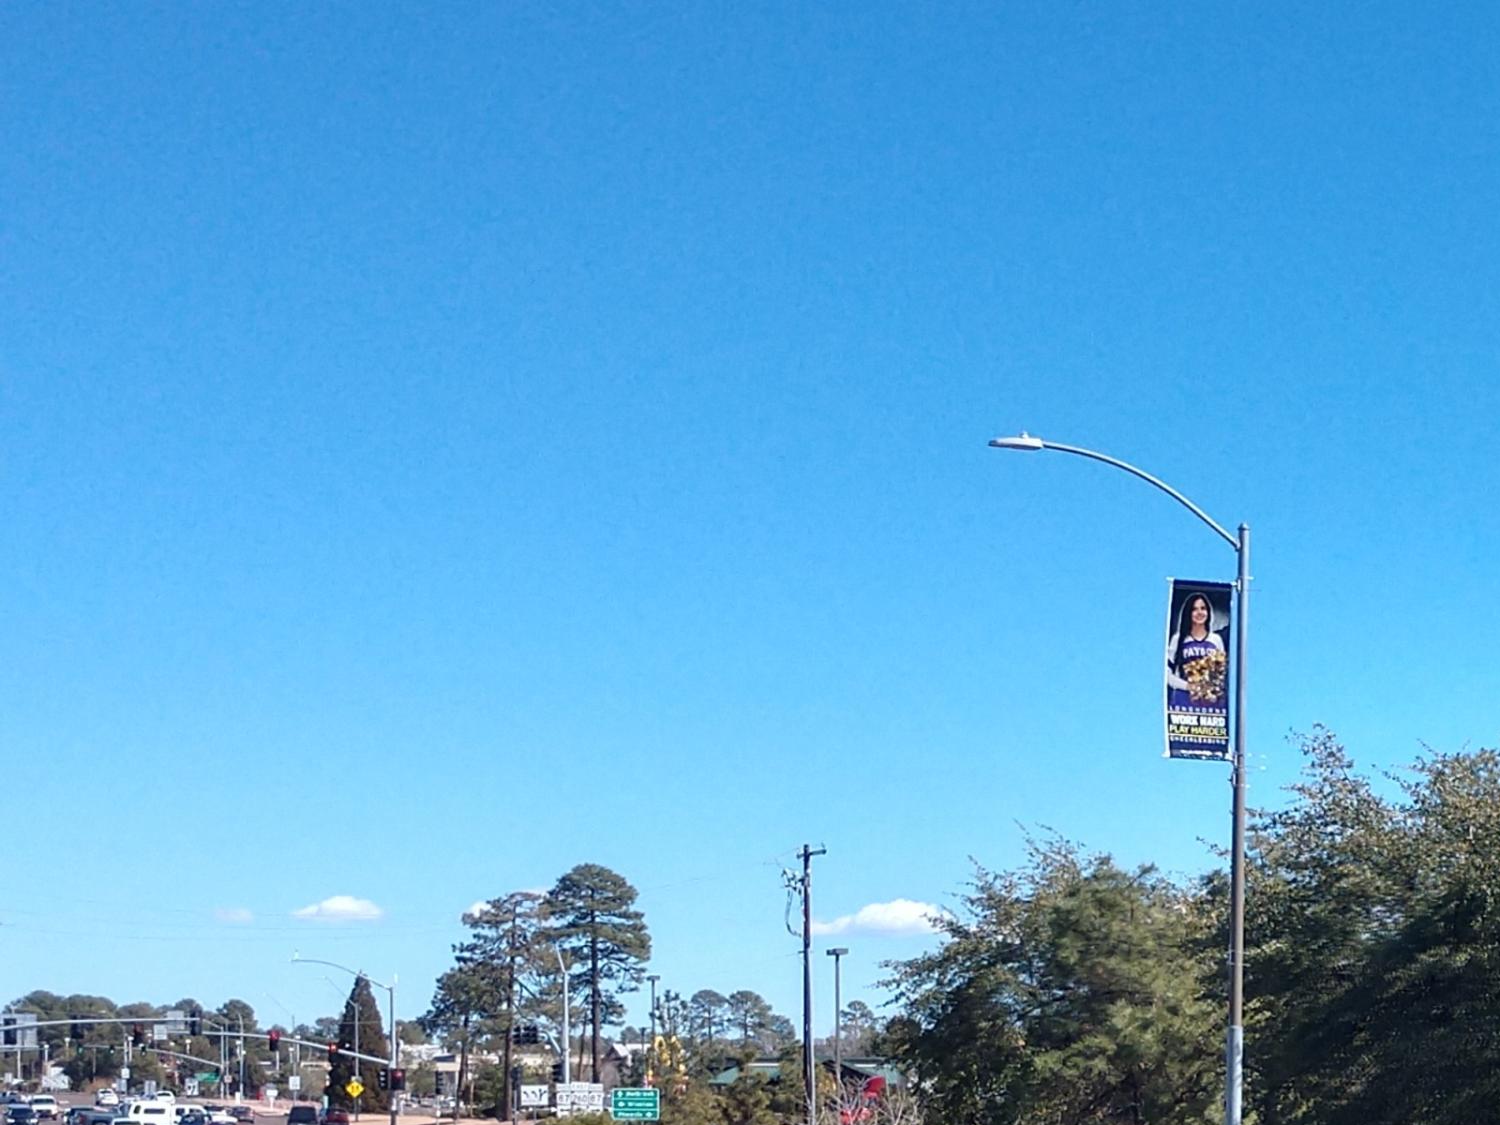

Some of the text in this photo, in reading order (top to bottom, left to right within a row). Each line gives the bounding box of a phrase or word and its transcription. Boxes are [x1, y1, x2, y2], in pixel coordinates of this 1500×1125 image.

[1169, 705, 1227, 714] LONGHORNS
[1170, 714, 1226, 728] WORK HARD
[1169, 725, 1227, 736] PLAY HARDER
